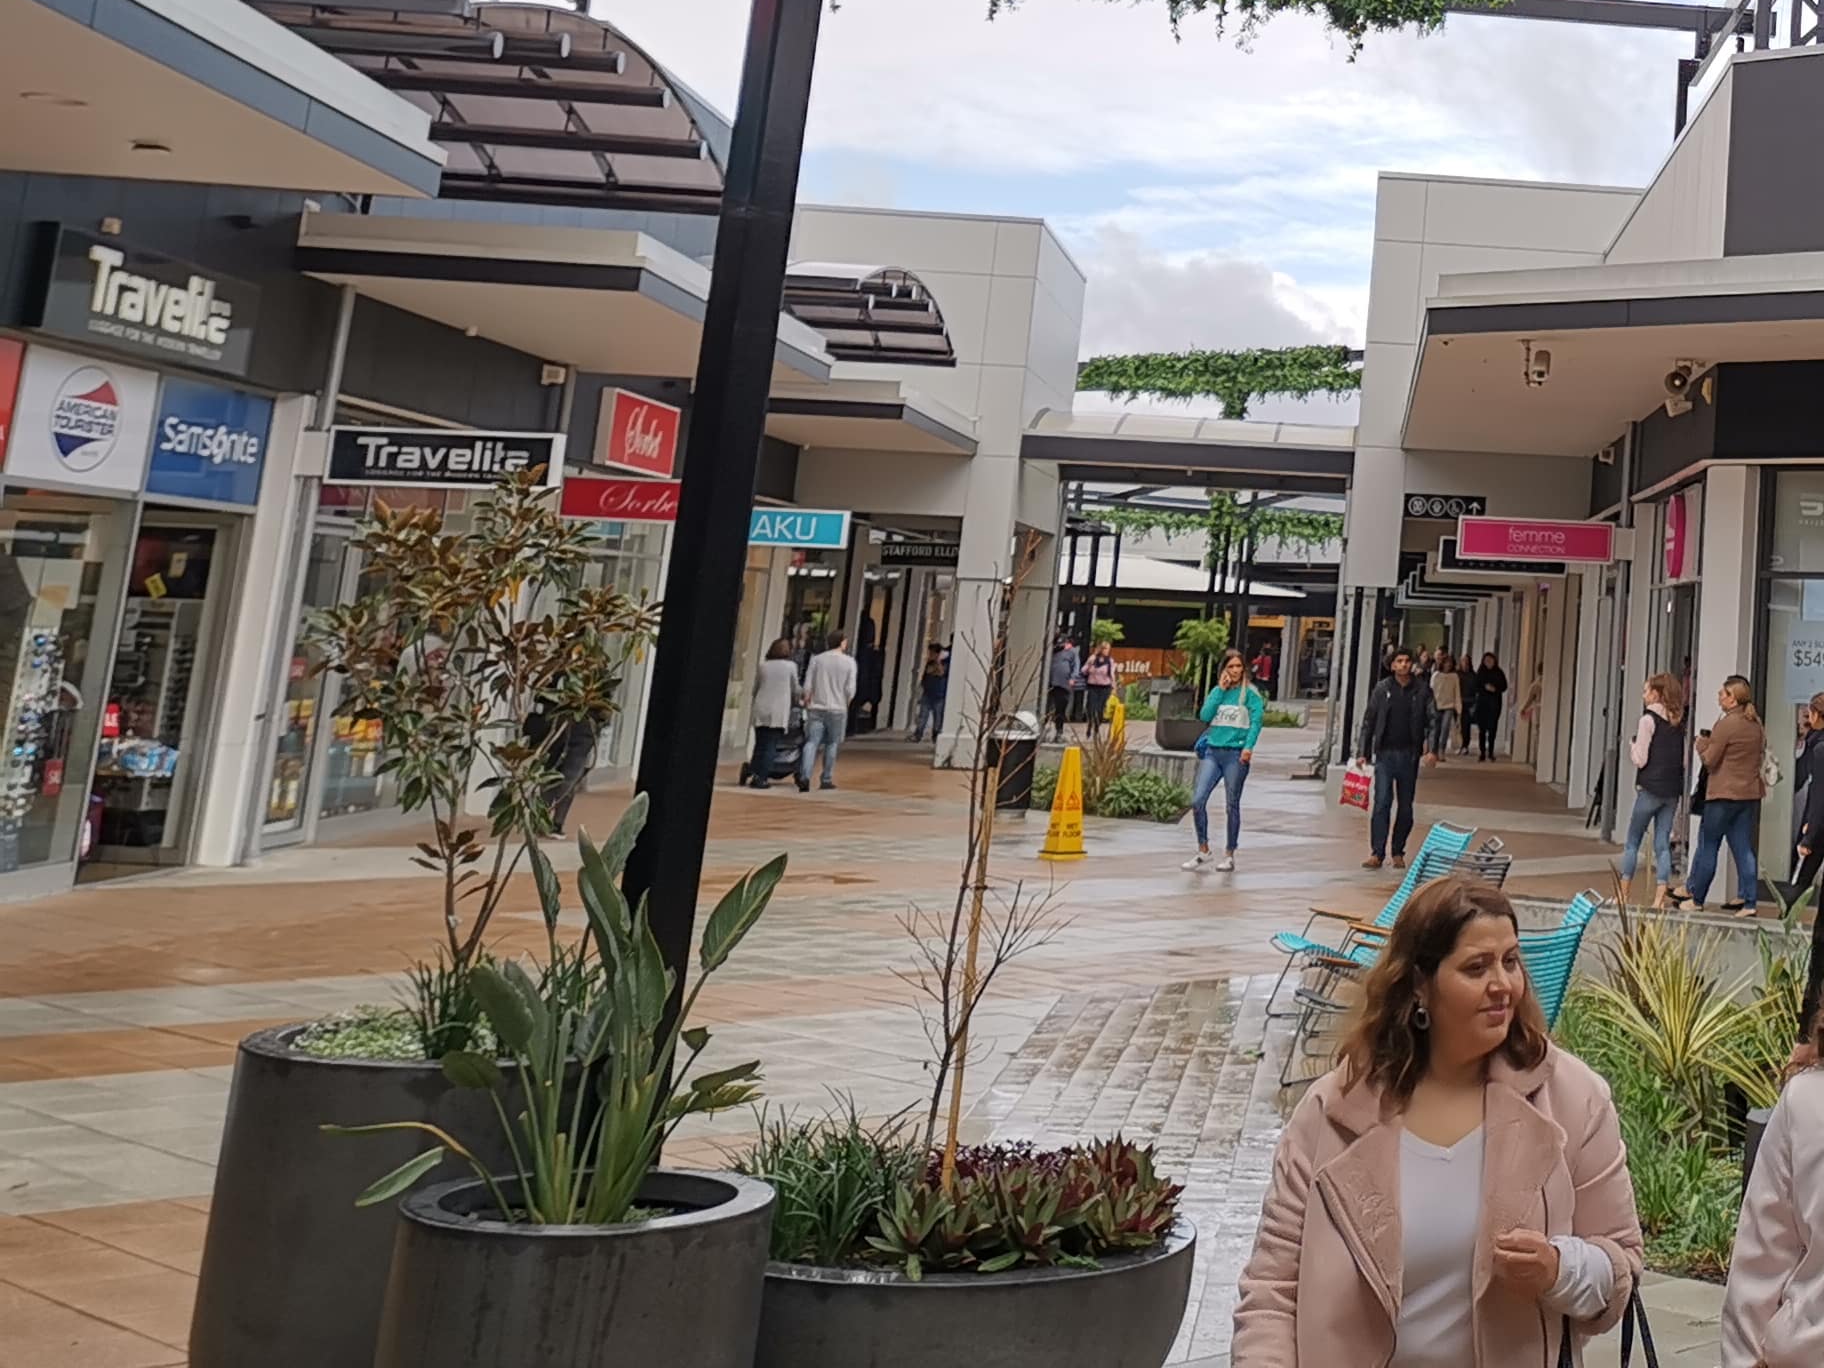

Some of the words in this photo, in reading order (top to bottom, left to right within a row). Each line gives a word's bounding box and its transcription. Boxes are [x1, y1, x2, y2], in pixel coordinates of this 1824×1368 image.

[56, 399, 118, 422] AMERICAN
[54, 414, 115, 436] TOURISTER
[160, 416, 260, 464] Samsonite
[1508, 526, 1566, 544] femme
[882, 544, 932, 556] STAFFORD
[1507, 543, 1566, 554] CONNECTION
[1792, 639, 1806, 648] ANY
